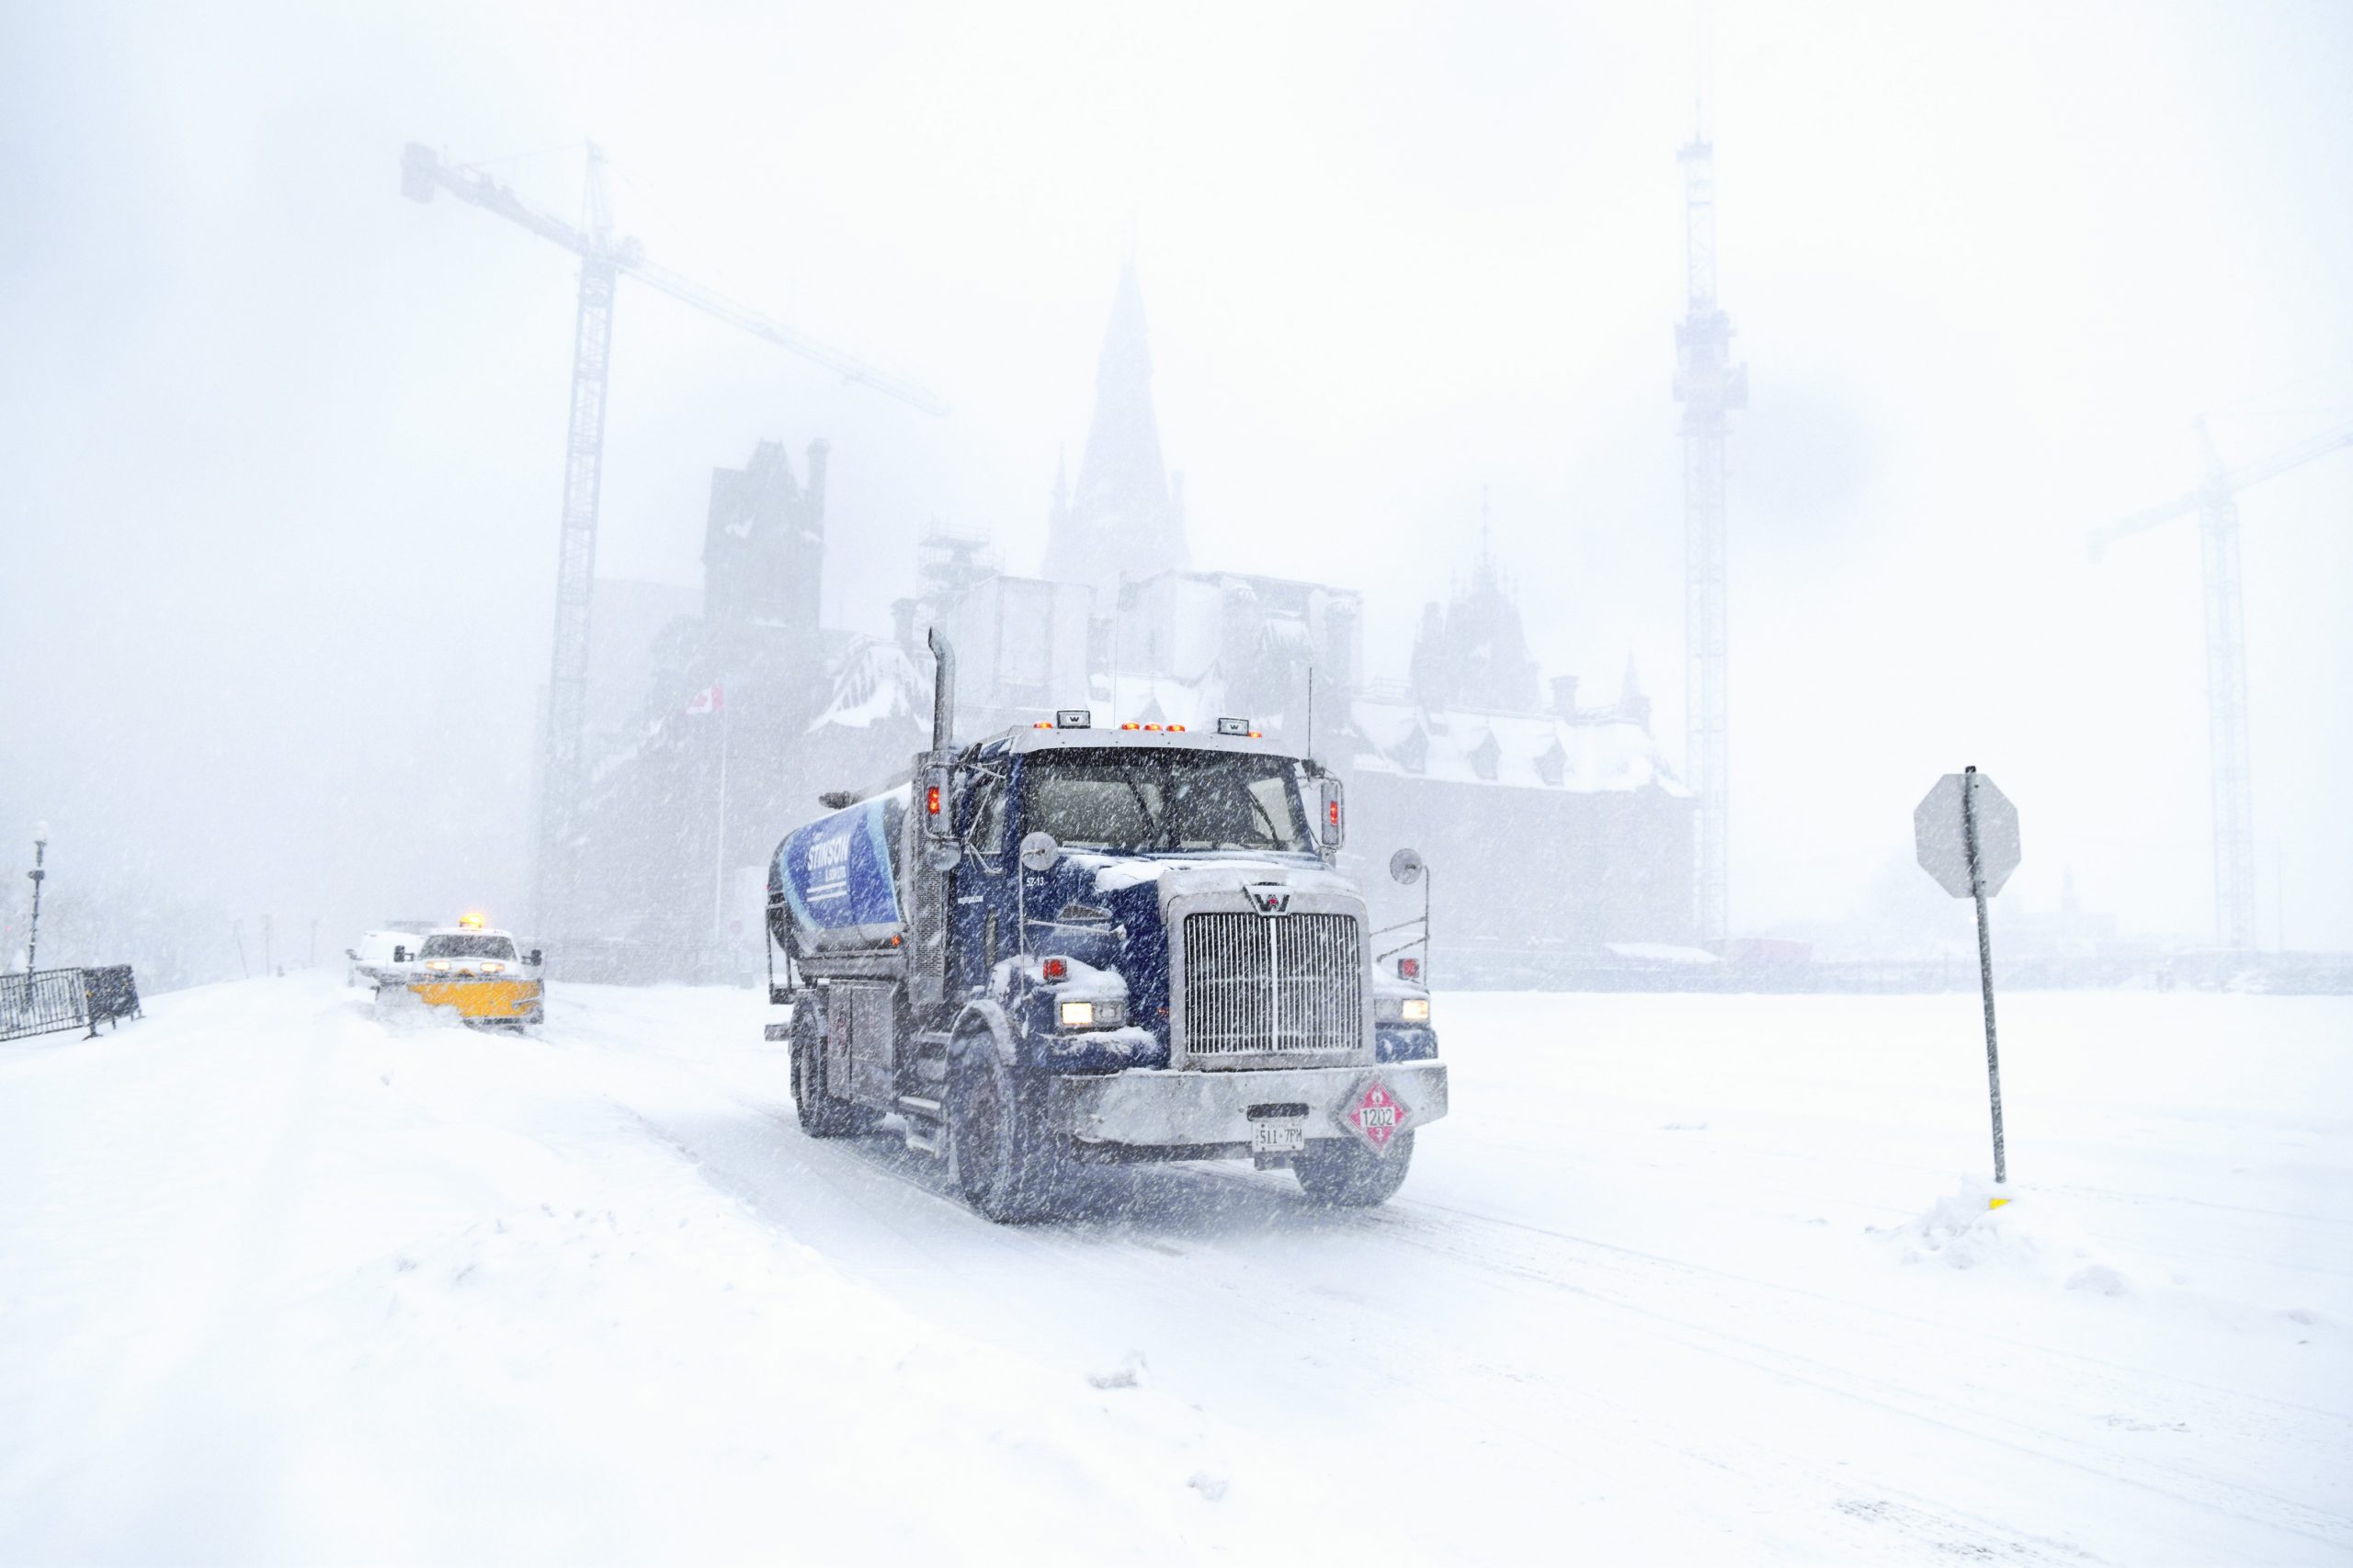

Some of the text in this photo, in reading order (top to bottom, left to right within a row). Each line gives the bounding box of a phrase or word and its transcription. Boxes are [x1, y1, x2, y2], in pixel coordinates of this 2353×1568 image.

[808, 834, 851, 870] STINSON
[1026, 876, 1044, 887] 52-13
[1362, 1108, 1393, 1127] 1202
[1375, 1129, 1384, 1142] 3
